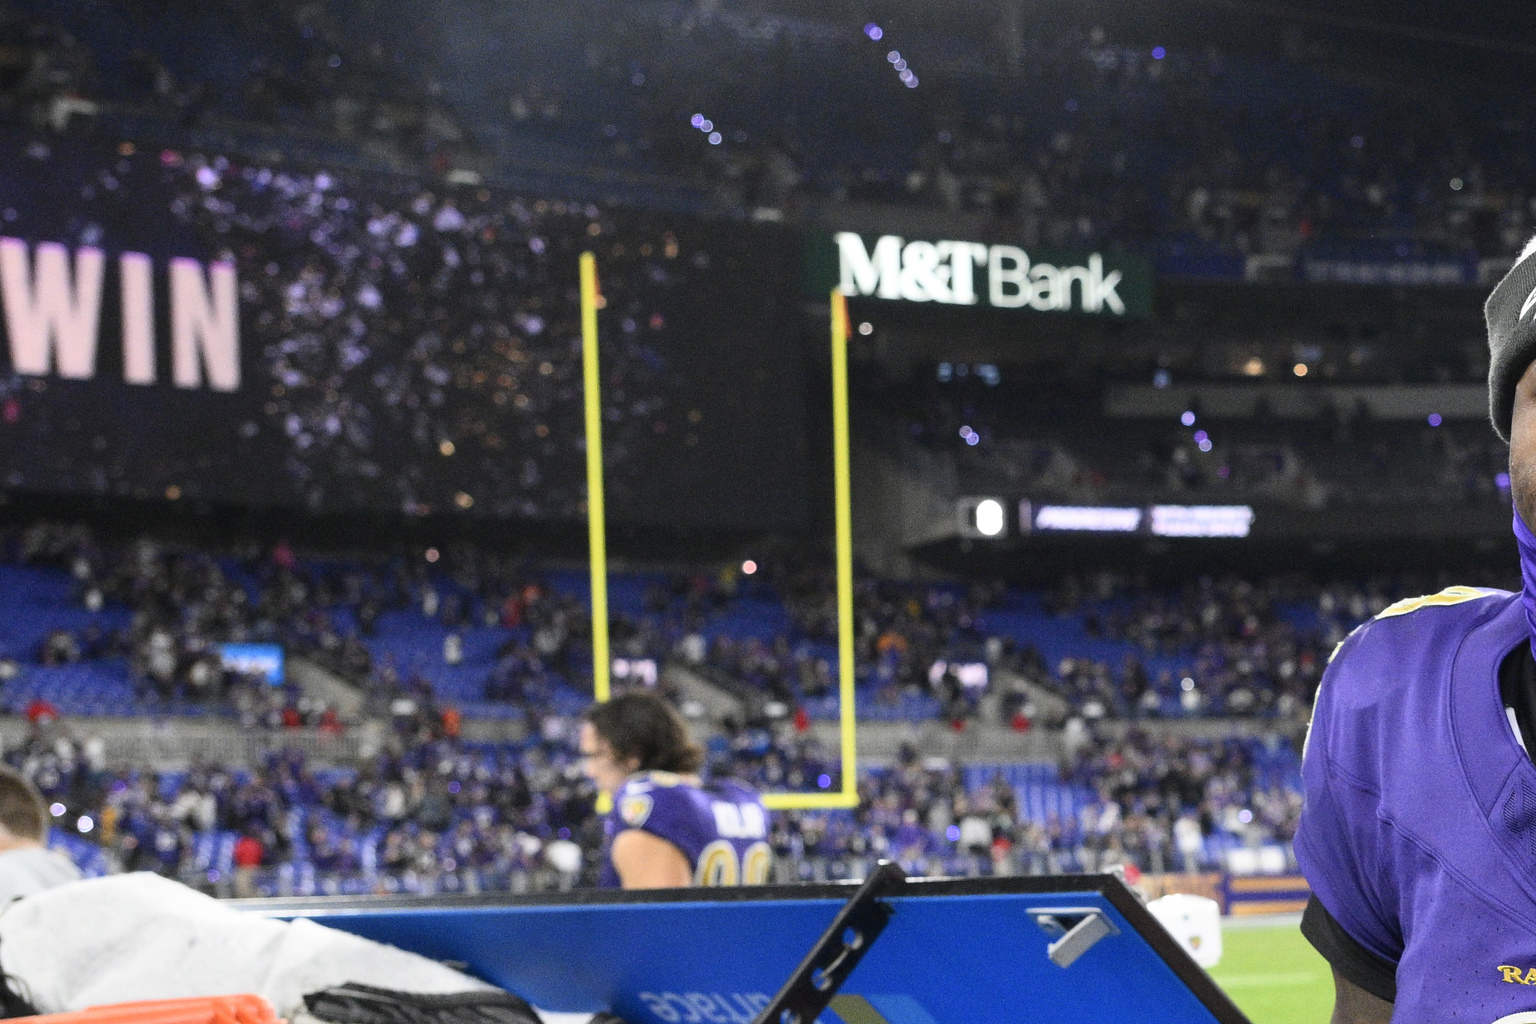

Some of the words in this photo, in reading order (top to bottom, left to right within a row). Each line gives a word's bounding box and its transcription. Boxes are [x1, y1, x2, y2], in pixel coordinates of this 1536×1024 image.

[0, 235, 242, 393] WIN
[835, 231, 988, 306] M&T
[989, 245, 1126, 316] Bank
